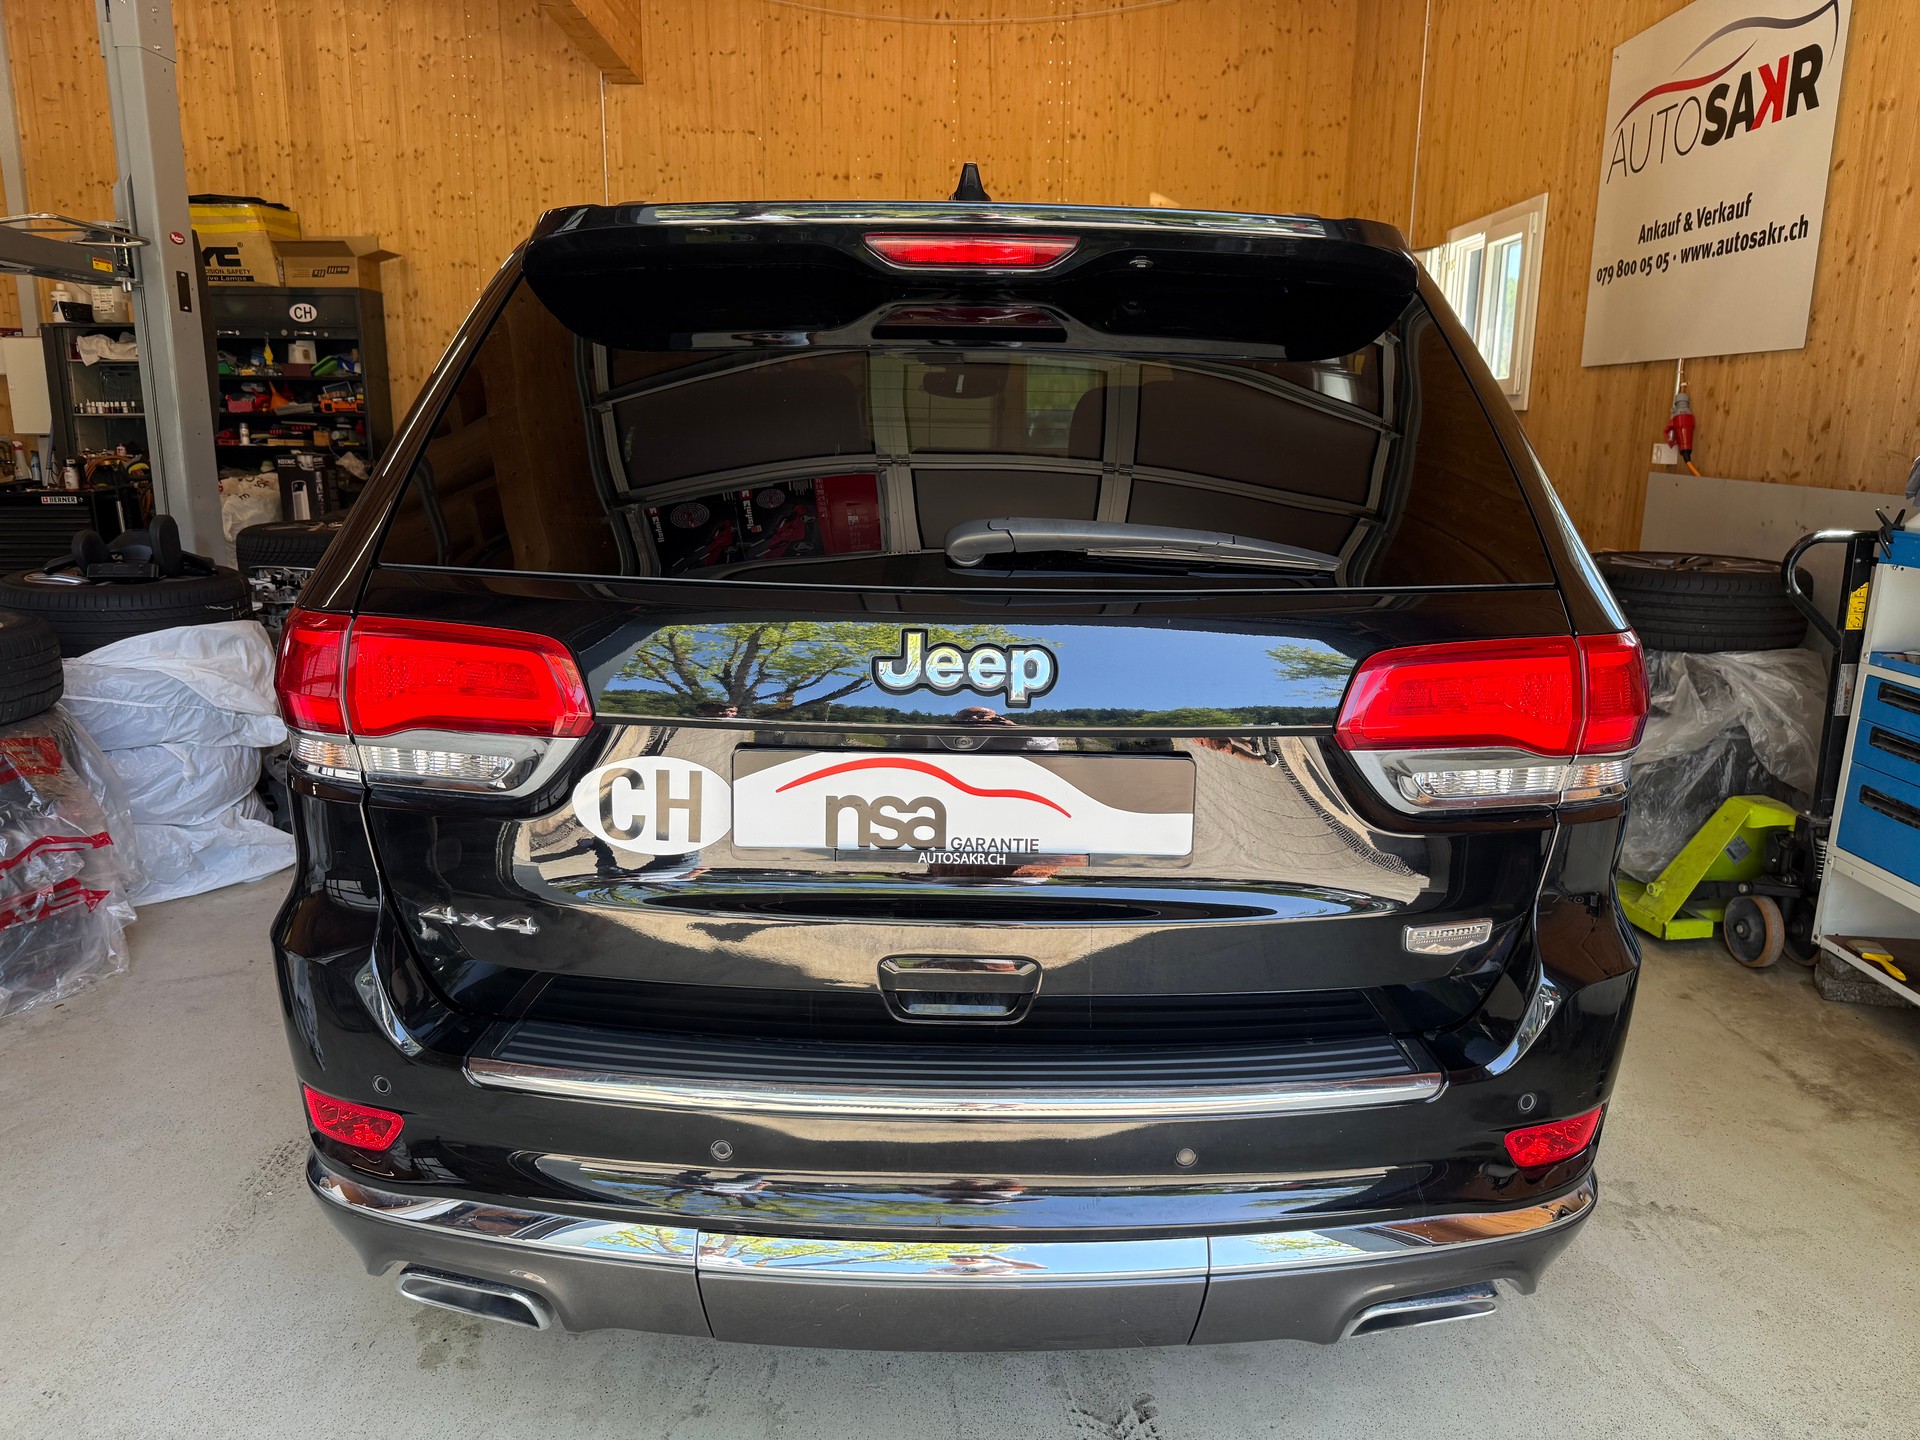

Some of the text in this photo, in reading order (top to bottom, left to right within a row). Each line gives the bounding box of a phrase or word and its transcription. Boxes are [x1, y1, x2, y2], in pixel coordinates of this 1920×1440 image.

[1606, 43, 1824, 185] AUTOSAKR
[1637, 192, 1753, 245] Ankauf & Verkauf
[1596, 213, 1809, 287] 079 800 05 05 www.autosakr.ch
[293, 306, 313, 320] CH
[876, 631, 1052, 702] Jeep
[598, 767, 703, 843] CH
[825, 794, 947, 850] nsa
[917, 851, 1006, 865] AUTOSAKR.CH
[950, 836, 1040, 852] GARANTIE
